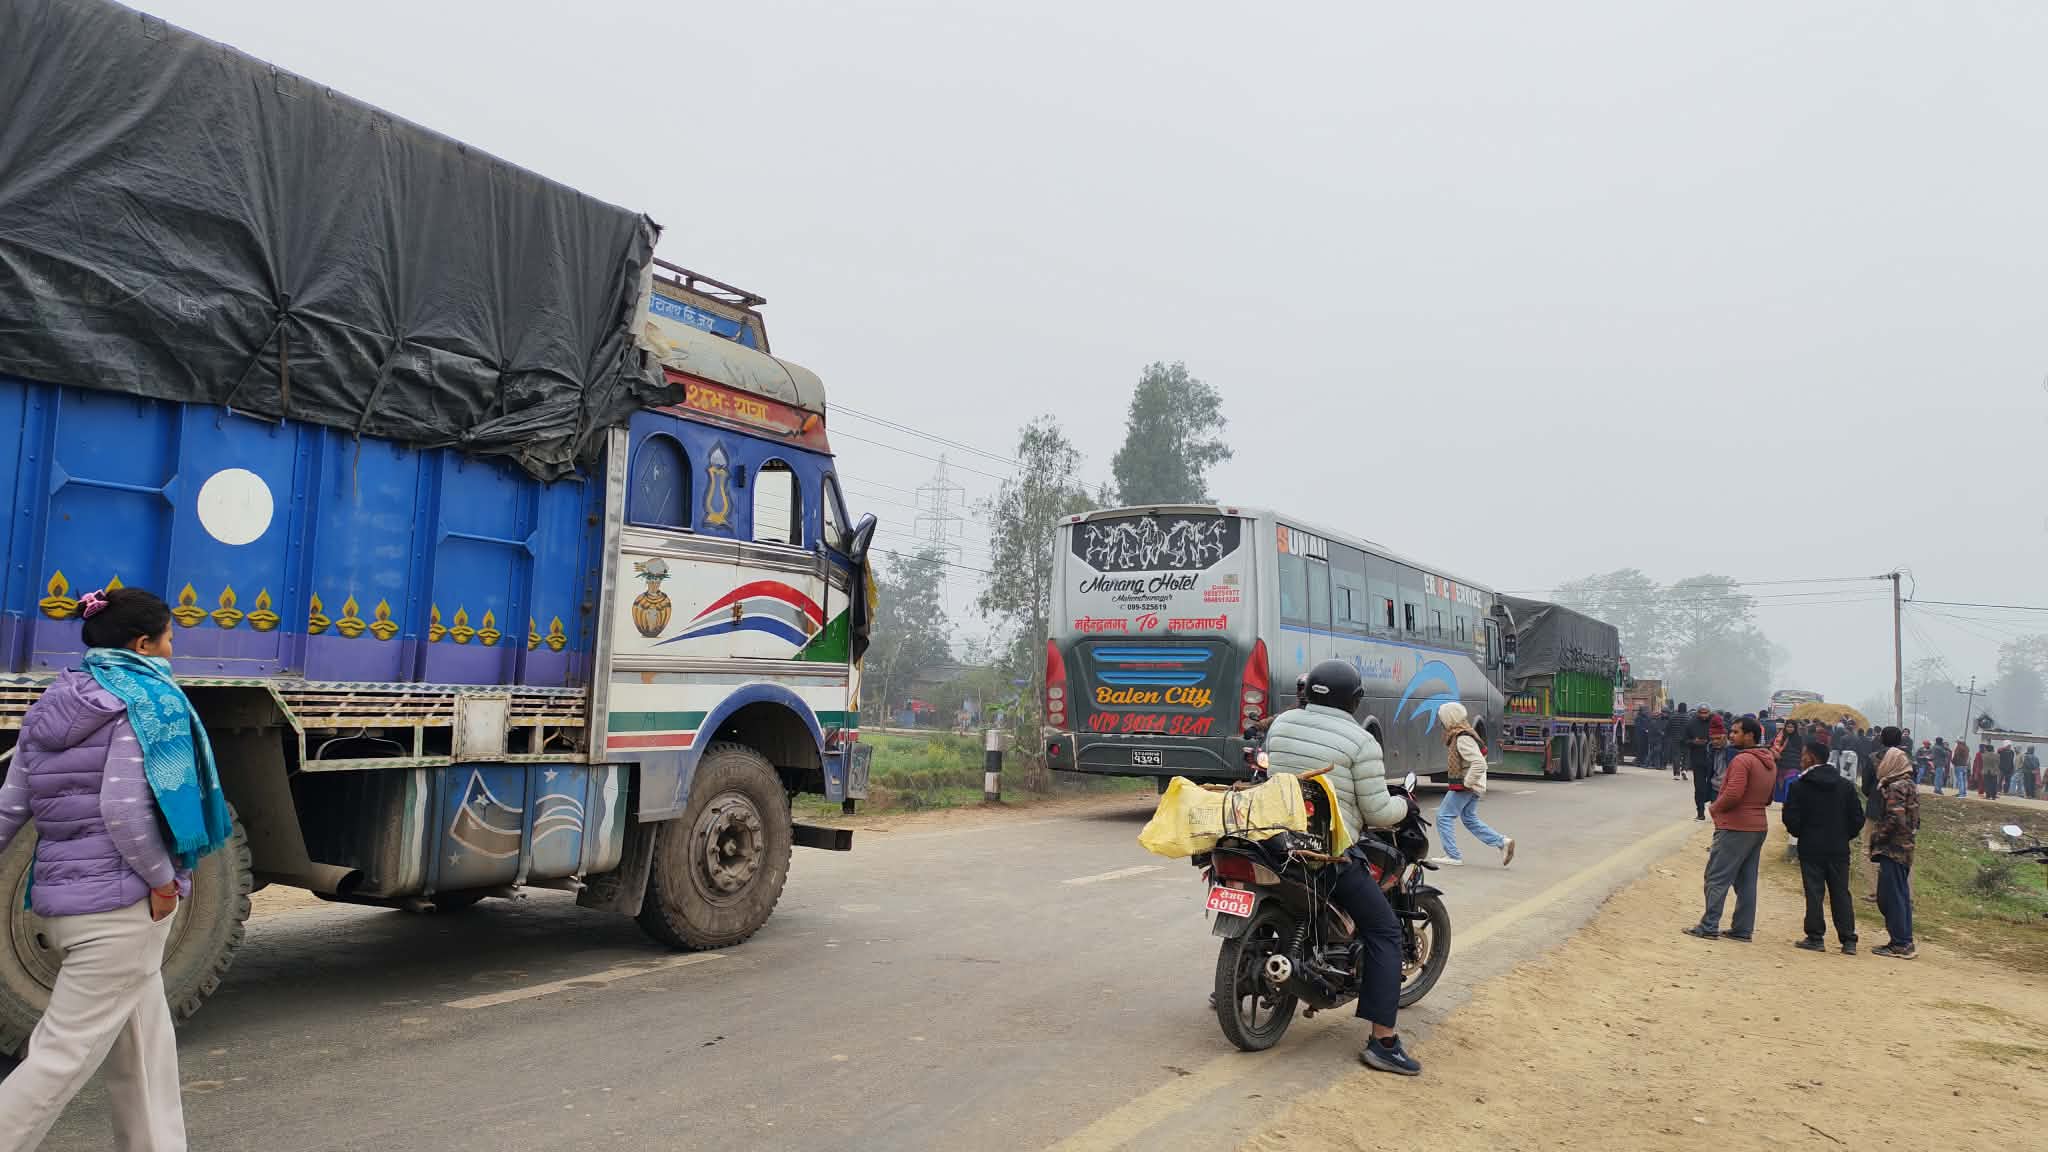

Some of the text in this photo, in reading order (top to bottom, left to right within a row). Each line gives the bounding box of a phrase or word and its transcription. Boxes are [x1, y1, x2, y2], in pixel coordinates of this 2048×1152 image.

[1080, 573, 1198, 594] Manang Hotel
[1136, 612, 1158, 632] To
[1096, 686, 1212, 708] Balen City
[1088, 712, 1216, 735] VIP SOFA SEAT
